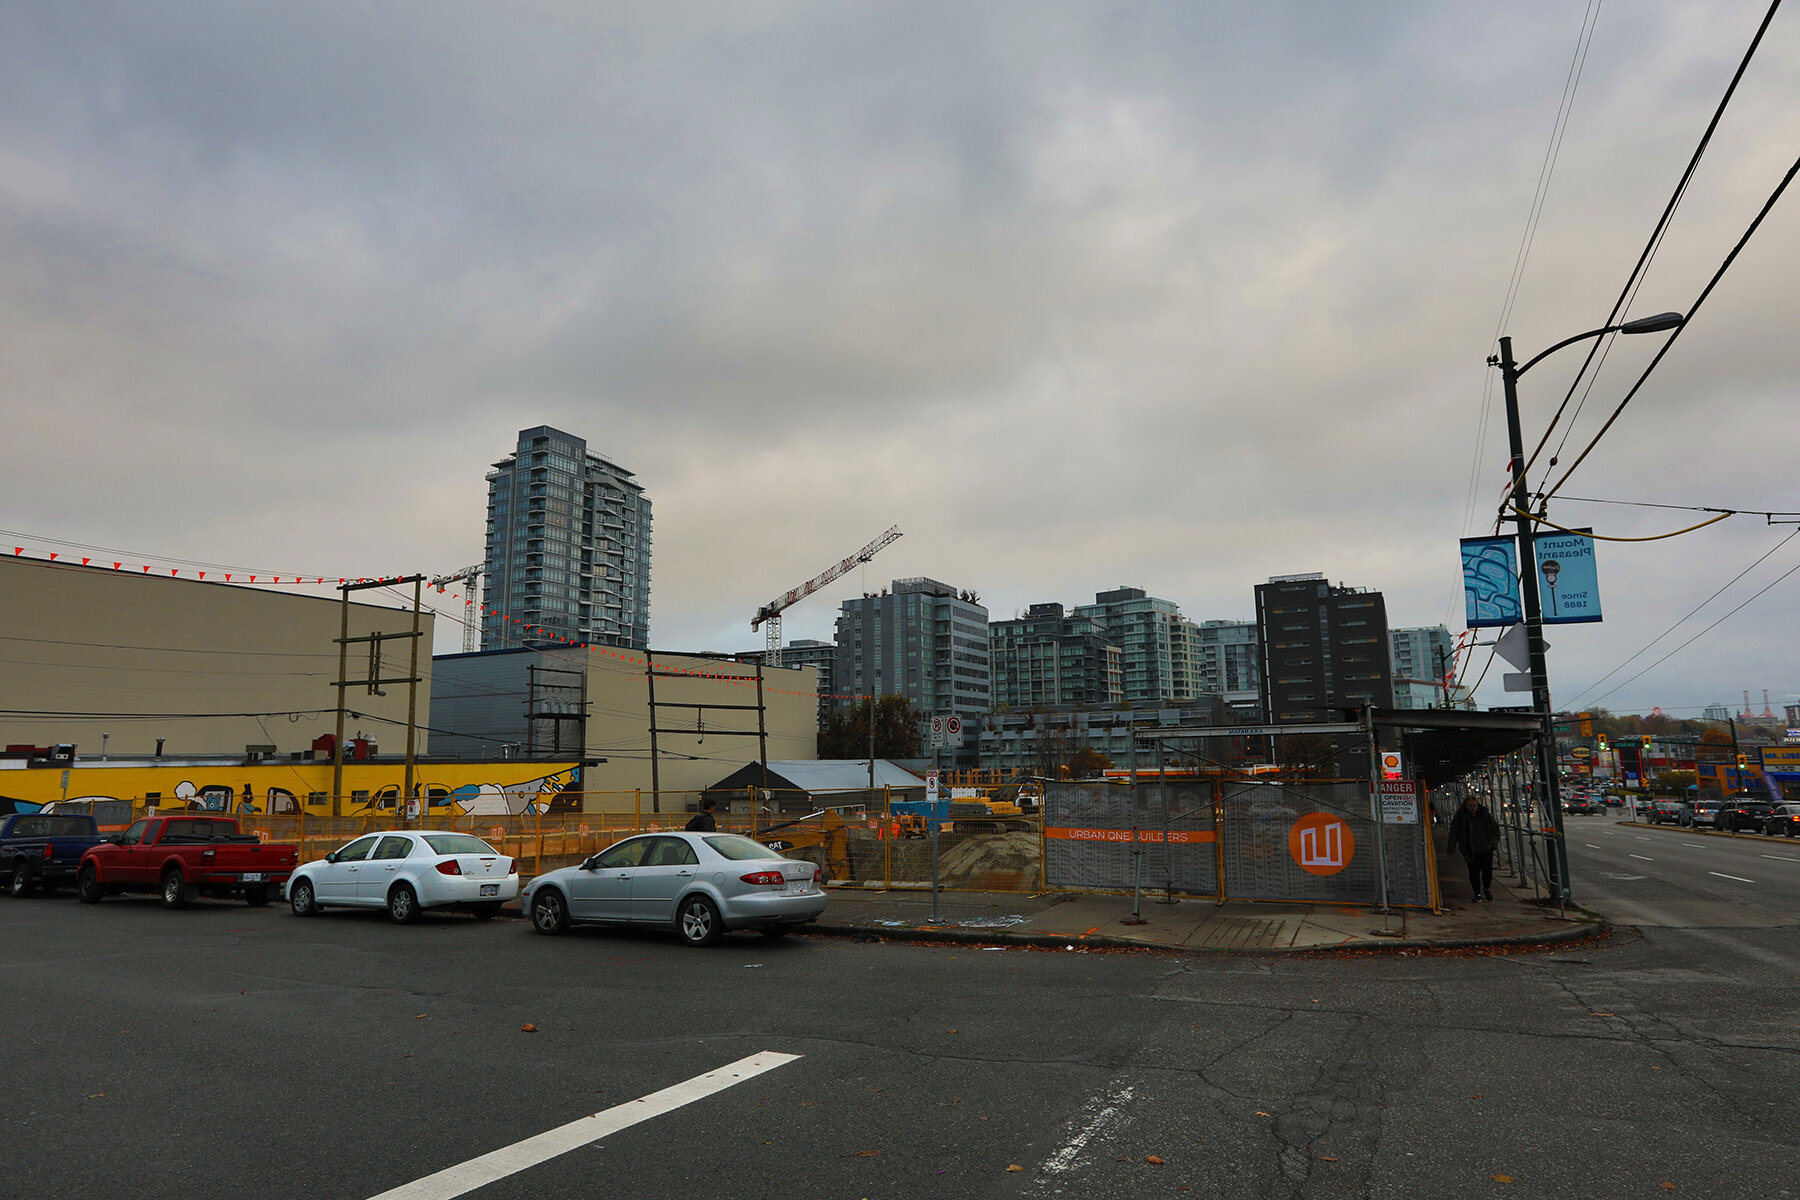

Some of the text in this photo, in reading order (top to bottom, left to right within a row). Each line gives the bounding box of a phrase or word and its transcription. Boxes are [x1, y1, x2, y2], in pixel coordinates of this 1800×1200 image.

[1380, 783, 1412, 793] ANGER
[1069, 830, 1105, 840] URBAN
[1108, 831, 1130, 841] ONE
[768, 841, 783, 850] CAT
